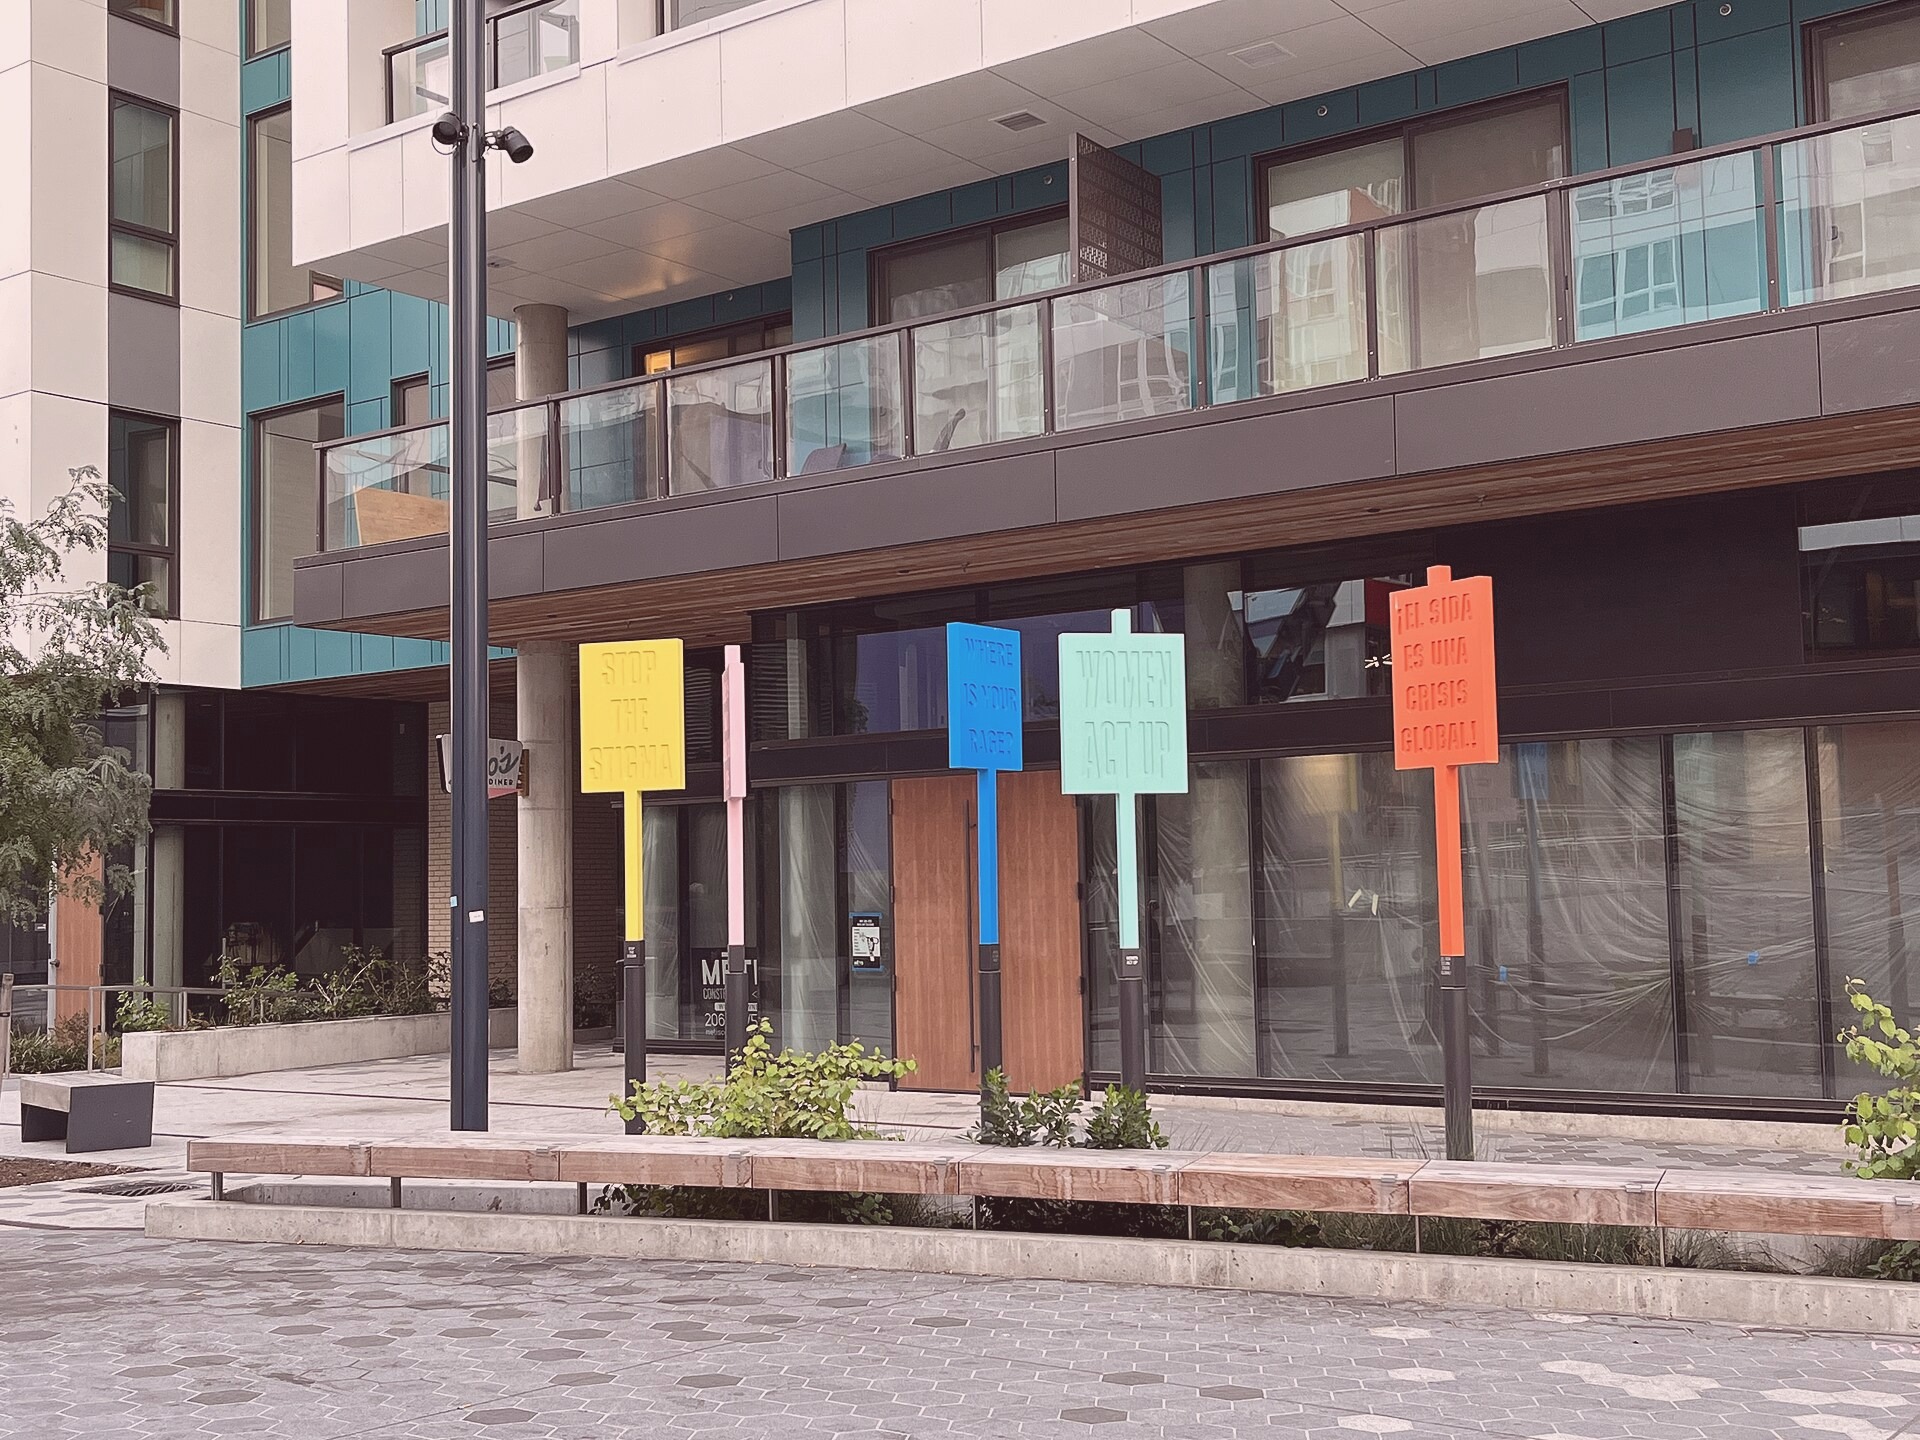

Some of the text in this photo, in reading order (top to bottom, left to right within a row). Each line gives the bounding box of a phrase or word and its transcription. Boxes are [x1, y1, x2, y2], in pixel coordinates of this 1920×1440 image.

[1430, 593, 1473, 624] SIDA
[965, 638, 1013, 665] WHERE
[1404, 637, 1468, 672] ES UNA
[602, 650, 656, 686] STOP
[1076, 650, 1172, 708] WOMEN
[963, 683, 1017, 711] IS YOUR
[1406, 679, 1468, 711] CRISIS
[610, 697, 648, 733] THE
[969, 729, 1013, 755] RAGE?
[1084, 721, 1170, 778] ACT UP
[1401, 720, 1476, 752] GLOBAL!
[488, 746, 519, 777] o's
[589, 743, 673, 781] STIGMA
[488, 778, 514, 786] DINER
